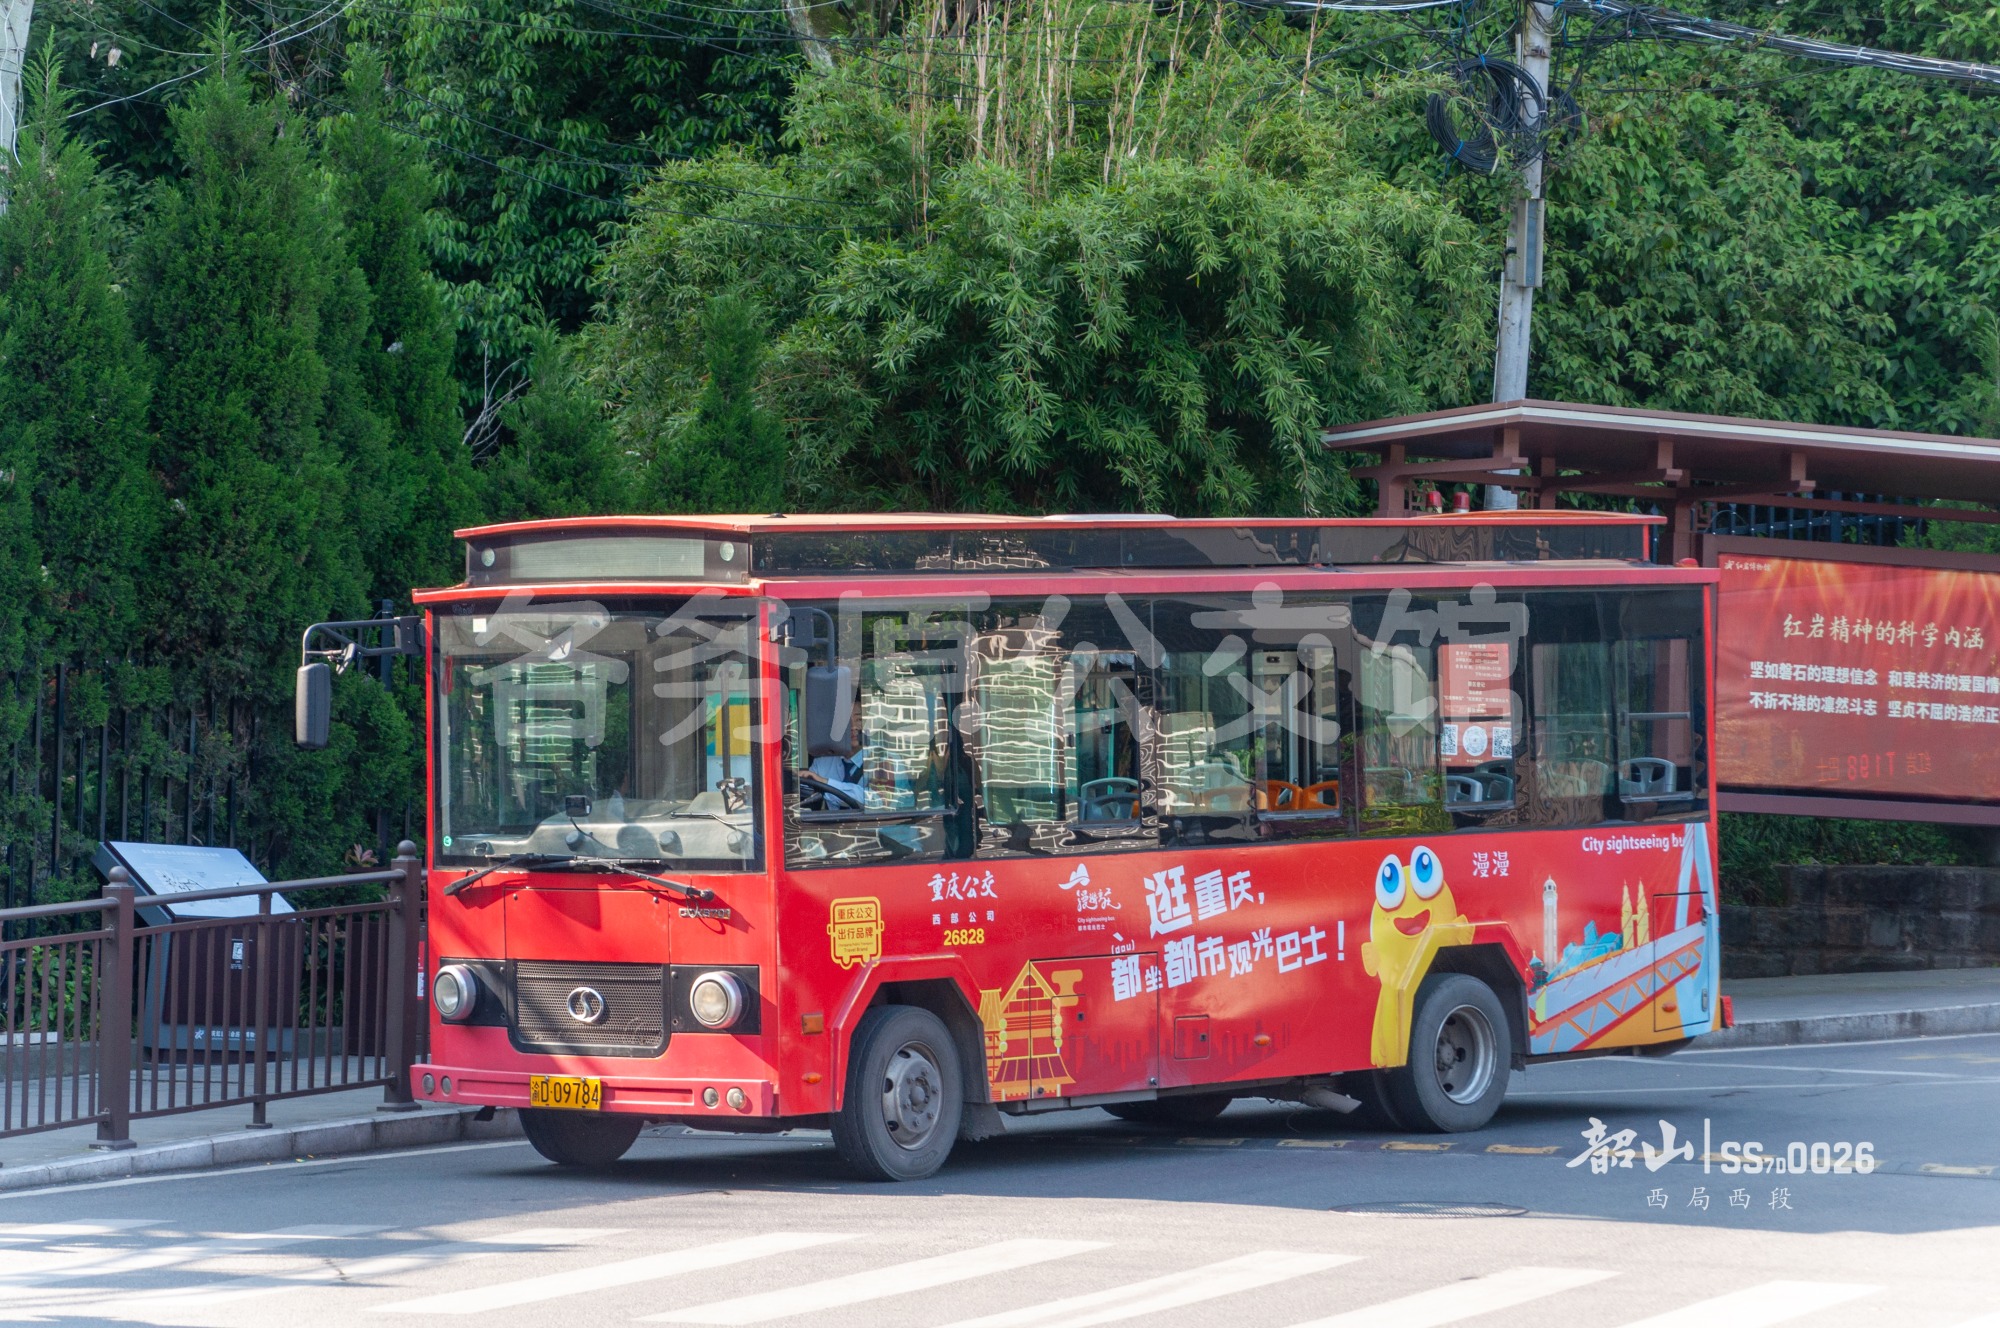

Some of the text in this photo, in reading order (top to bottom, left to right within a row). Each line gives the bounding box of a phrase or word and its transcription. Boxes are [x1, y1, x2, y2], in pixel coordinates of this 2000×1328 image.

[1783, 612, 1984, 650] 红岩精神的科学内涵
[1750, 660, 2000, 694] 坚如磐石的理想信念 和衷共济的爱国情
[1750, 691, 2000, 724] 不折不挠的凛然斗志 坚贞不屈的浩然正
[1582, 832, 1687, 855] City sightseeing bu
[1472, 851, 1510, 878] 漫漫
[927, 870, 998, 902] 重庆公交
[837, 907, 873, 920] 重庆公交
[932, 910, 995, 926] 西部公司
[838, 927, 873, 940] 出行品牌
[943, 927, 985, 946] 26828
